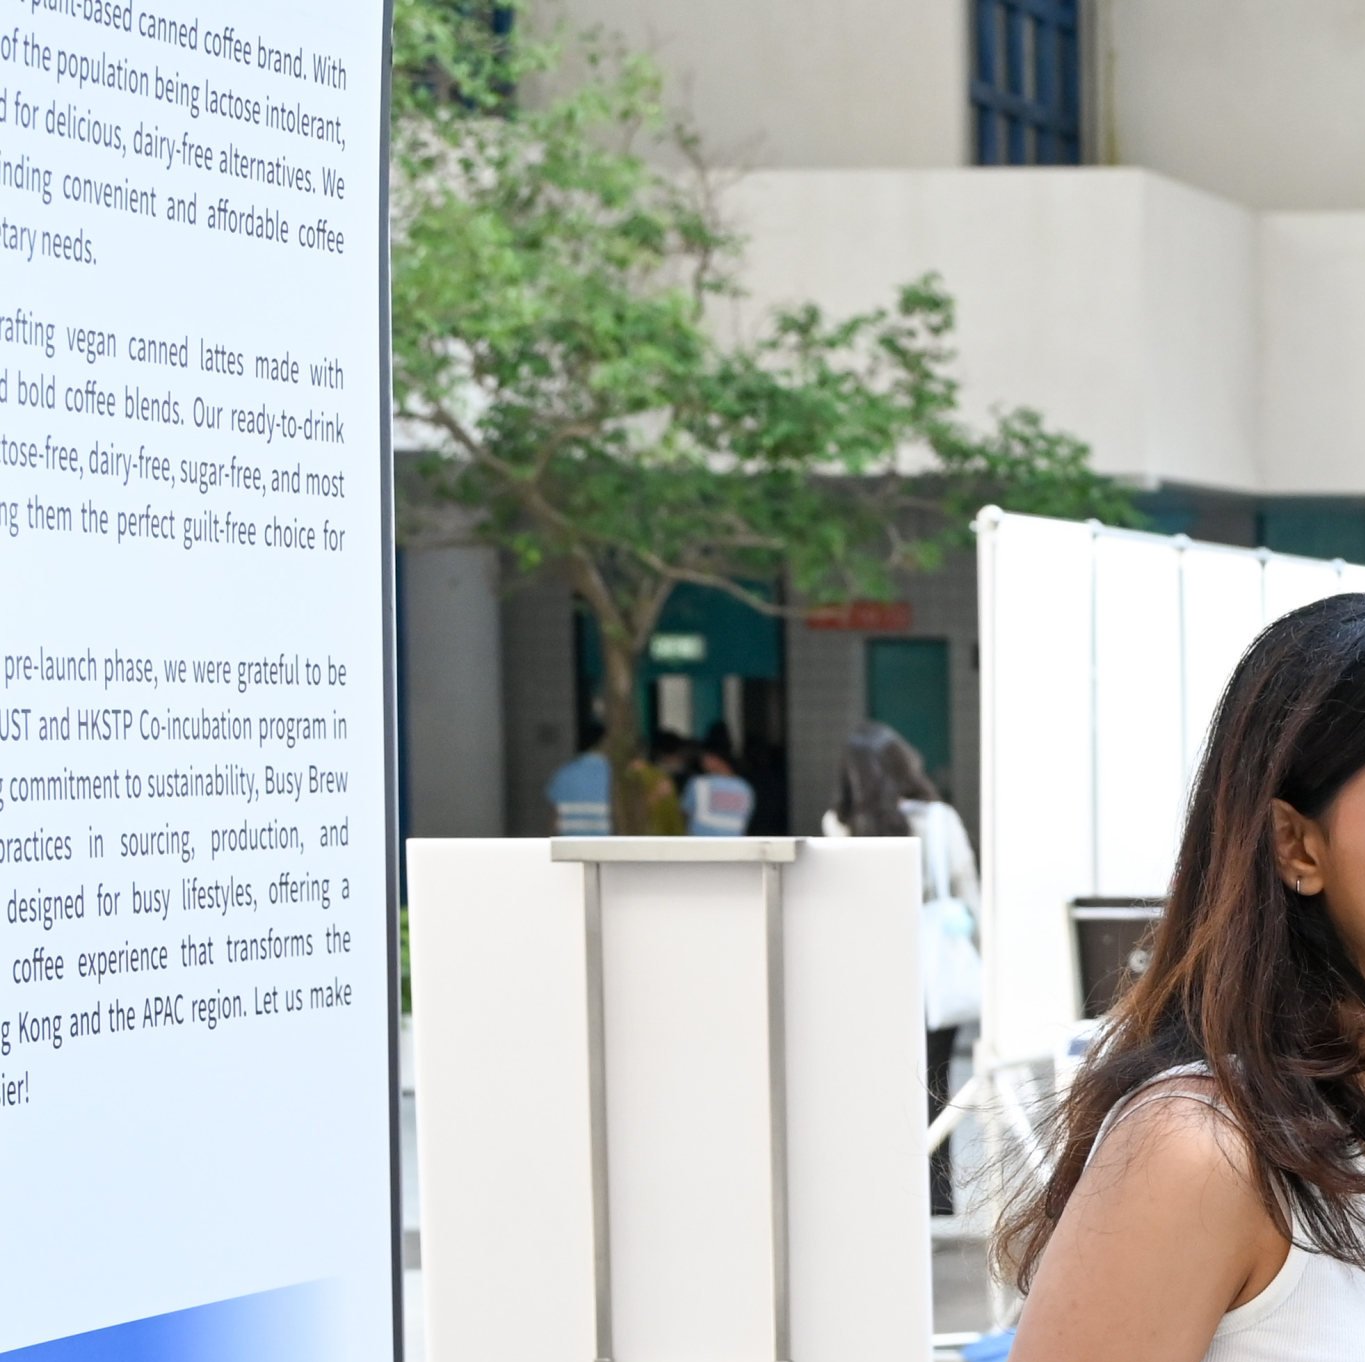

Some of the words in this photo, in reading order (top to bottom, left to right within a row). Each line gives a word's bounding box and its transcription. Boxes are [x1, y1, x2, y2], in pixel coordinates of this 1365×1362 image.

[138, 11, 199, 51] canned
[203, 25, 252, 66] coffee
[257, 35, 307, 81] brand.
[312, 52, 347, 91] With
[0, 26, 20, 63] of
[22, 31, 52, 72] the
[56, 49, 149, 97] population
[154, 65, 201, 120] being
[204, 78, 261, 126] lactose
[265, 95, 346, 153] intolerant,
[14, 90, 40, 131] for
[45, 99, 127, 159] delicious,
[132, 120, 214, 172] dairy-free
[218, 142, 316, 195] alternatives.
[321, 166, 345, 201] We
[62, 174, 157, 218] convenient
[166, 191, 197, 226] and
[207, 197, 289, 244] affordable
[298, 218, 345, 255] coffee
[41, 227, 97, 266] needs.
[66, 326, 117, 365] vegan
[128, 335, 189, 369] canned
[200, 337, 245, 377] lattes
[255, 350, 300, 385] made
[309, 356, 344, 391] with
[17, 369, 56, 410] bold
[64, 379, 116, 418] coffee
[124, 384, 185, 426] blends.
[193, 396, 224, 430] Our
[231, 402, 345, 445] ready-to-drink
[88, 440, 176, 489] dairy-free,
[179, 454, 267, 498] sugar-free,
[271, 462, 301, 495] and
[305, 470, 345, 499] most
[26, 493, 72, 532] them
[80, 499, 109, 535] the
[117, 503, 176, 545] perfect
[182, 509, 257, 551] guilt-free
[264, 515, 316, 551] choice
[322, 518, 346, 552] for
[4, 645, 97, 690] pre-launch
[104, 647, 158, 691] phase,
[163, 659, 187, 684] we
[192, 660, 232, 685] were
[237, 652, 300, 694] grateful
[304, 657, 322, 686] to
[327, 654, 347, 687] be
[38, 706, 71, 742] and
[77, 708, 133, 741] HKSTP
[139, 707, 252, 741] Co-incubation
[258, 716, 327, 750] program
[332, 708, 348, 740] in
[9, 766, 121, 803] commitment
[124, 768, 142, 800] to
[147, 763, 260, 805] sustainability,
[264, 764, 303, 803] Busy
[308, 764, 349, 794] Brew
[88, 824, 104, 859] in
[120, 821, 196, 864] sourcing,
[210, 818, 305, 862] production,
[319, 815, 349, 848] and
[6, 883, 85, 932] designed
[96, 882, 121, 917] for
[132, 880, 171, 922] busy
[181, 875, 258, 917] lifestyles,
[268, 871, 331, 910] offering
[341, 877, 350, 900] a
[12, 945, 65, 985] coffee
[77, 939, 168, 985] experience
[180, 933, 215, 968] that
[225, 926, 314, 964] transforms
[325, 922, 352, 955] the
[18, 1010, 63, 1050] Kong
[69, 1000, 101, 1038] and
[107, 998, 136, 1033] the
[142, 993, 185, 1029] APAC
[191, 987, 247, 1031] region.
[254, 985, 279, 1016] Let
[285, 988, 304, 1013] us
[309, 975, 353, 1010] make
